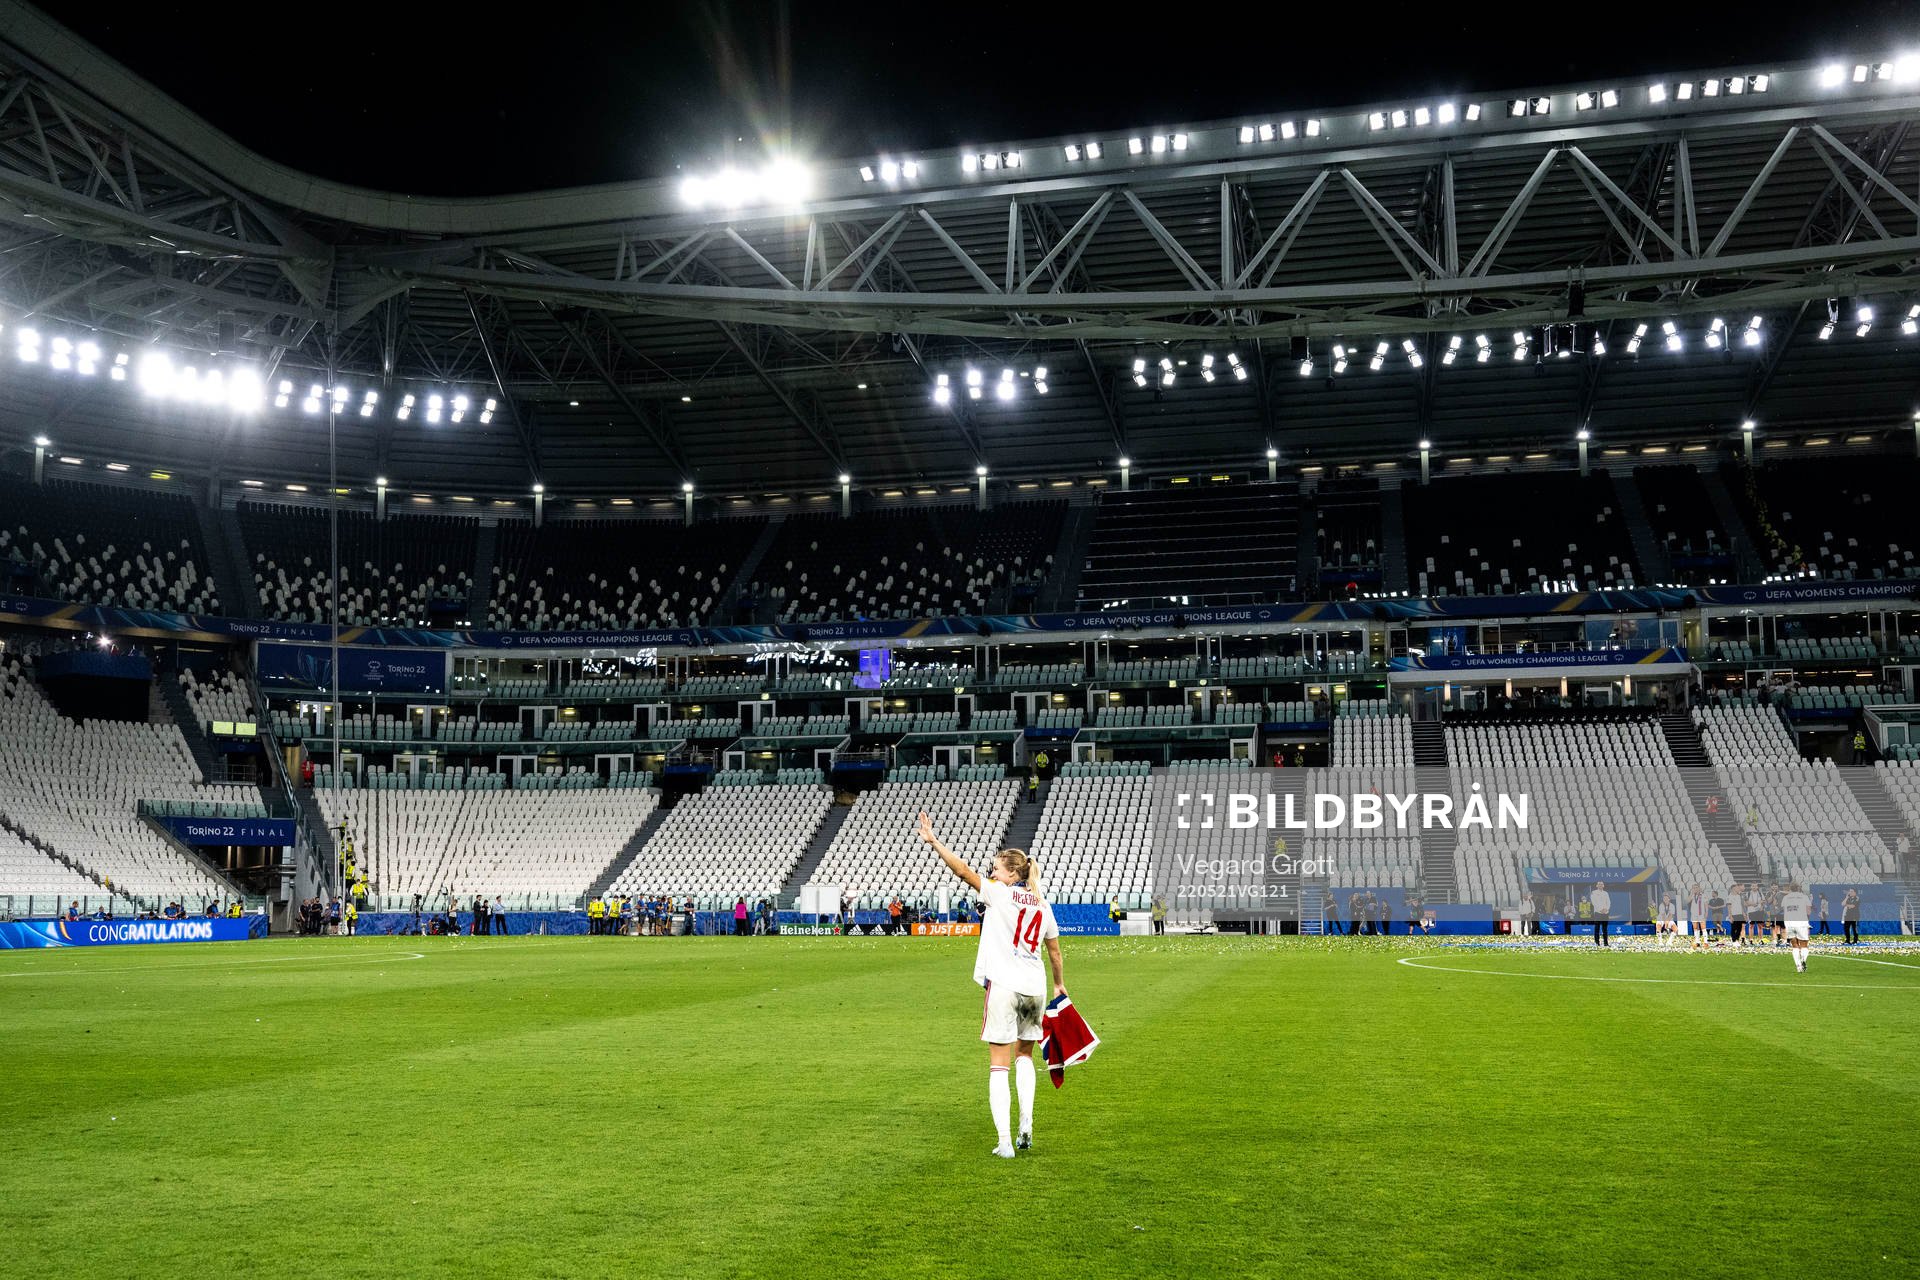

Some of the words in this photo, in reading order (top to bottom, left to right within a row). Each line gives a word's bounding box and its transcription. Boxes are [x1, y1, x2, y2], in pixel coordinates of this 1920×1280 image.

[1765, 590, 1792, 599] UEFA
[1083, 617, 1105, 626] UEFA
[1154, 612, 1212, 622] CHAPIONS
[1215, 611, 1251, 620] LEAGUE
[260, 624, 270, 633] 22
[276, 627, 314, 636] FINAL
[835, 627, 844, 635] 22
[586, 635, 640, 644] CHAMPIONS
[641, 634, 673, 642] LEAGUE
[1526, 656, 1576, 664] CHAMPIONS
[1578, 654, 1608, 662] LEAGUE
[416, 665, 426, 674] 22
[222, 827, 235, 836] 22
[241, 828, 285, 837] FINAL
[89, 921, 213, 942] CONGRATULATIONS
[780, 925, 831, 935] Heineken
[929, 925, 952, 934] JUST
[955, 924, 974, 934] EAT
[1013, 907, 1043, 953] 14
